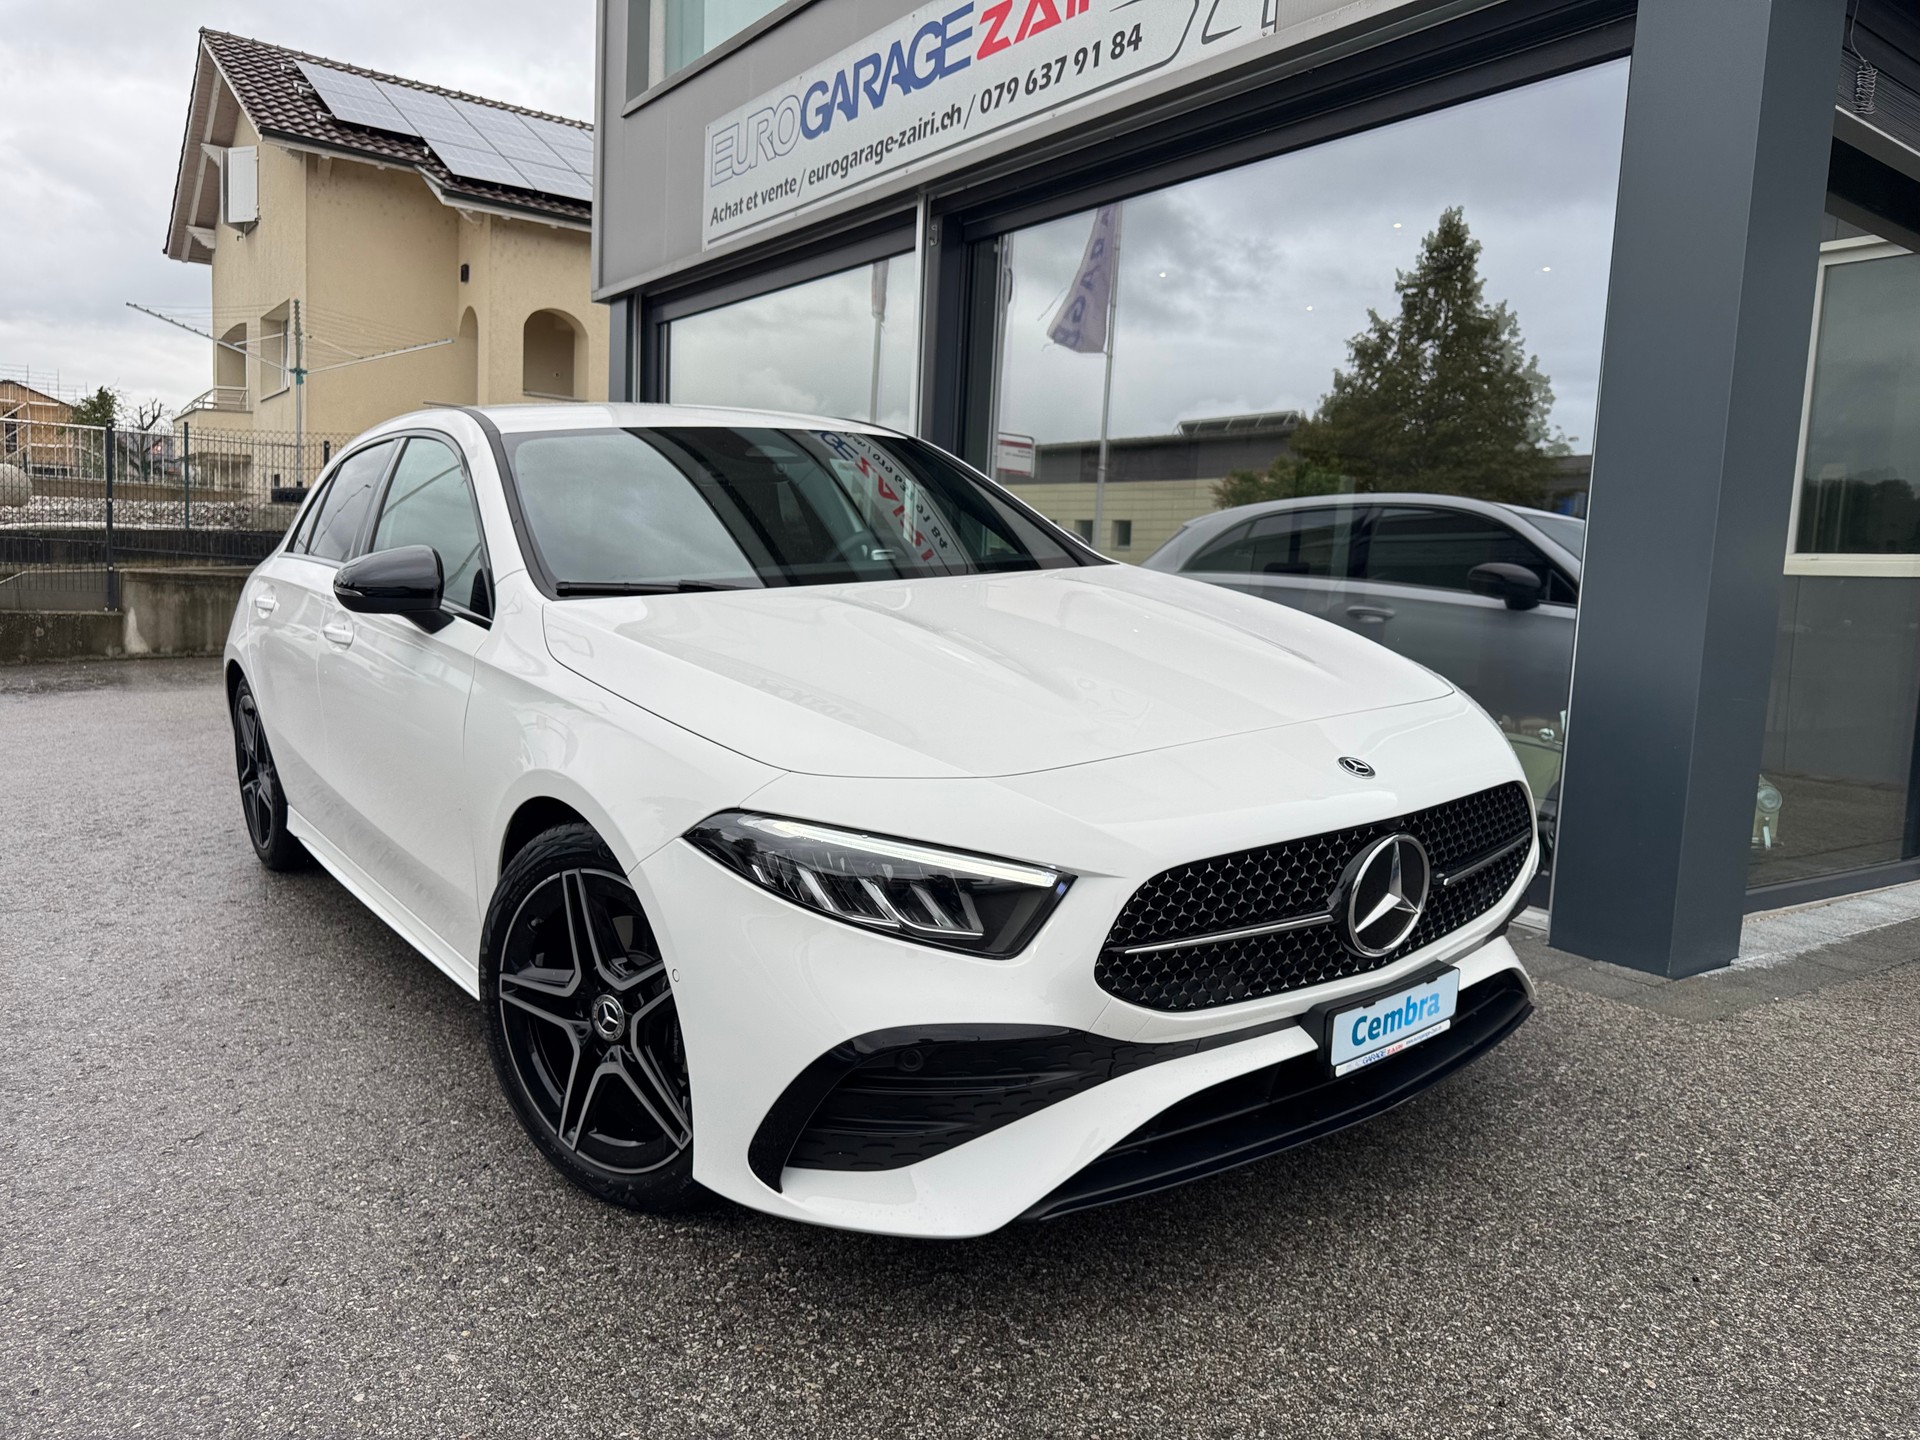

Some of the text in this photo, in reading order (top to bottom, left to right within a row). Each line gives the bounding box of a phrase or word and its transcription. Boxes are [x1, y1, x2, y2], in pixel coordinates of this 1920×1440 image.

[710, 196, 744, 227] Achat
[746, 191, 759, 211] et
[761, 177, 797, 205] vente
[808, 103, 962, 185] eurogarage-zairi.ch
[980, 76, 1019, 115] 079
[1024, 55, 1068, 96] 637
[1073, 40, 1101, 76] 91
[1110, 22, 1143, 61] 84
[1351, 993, 1440, 1047] Cembra
